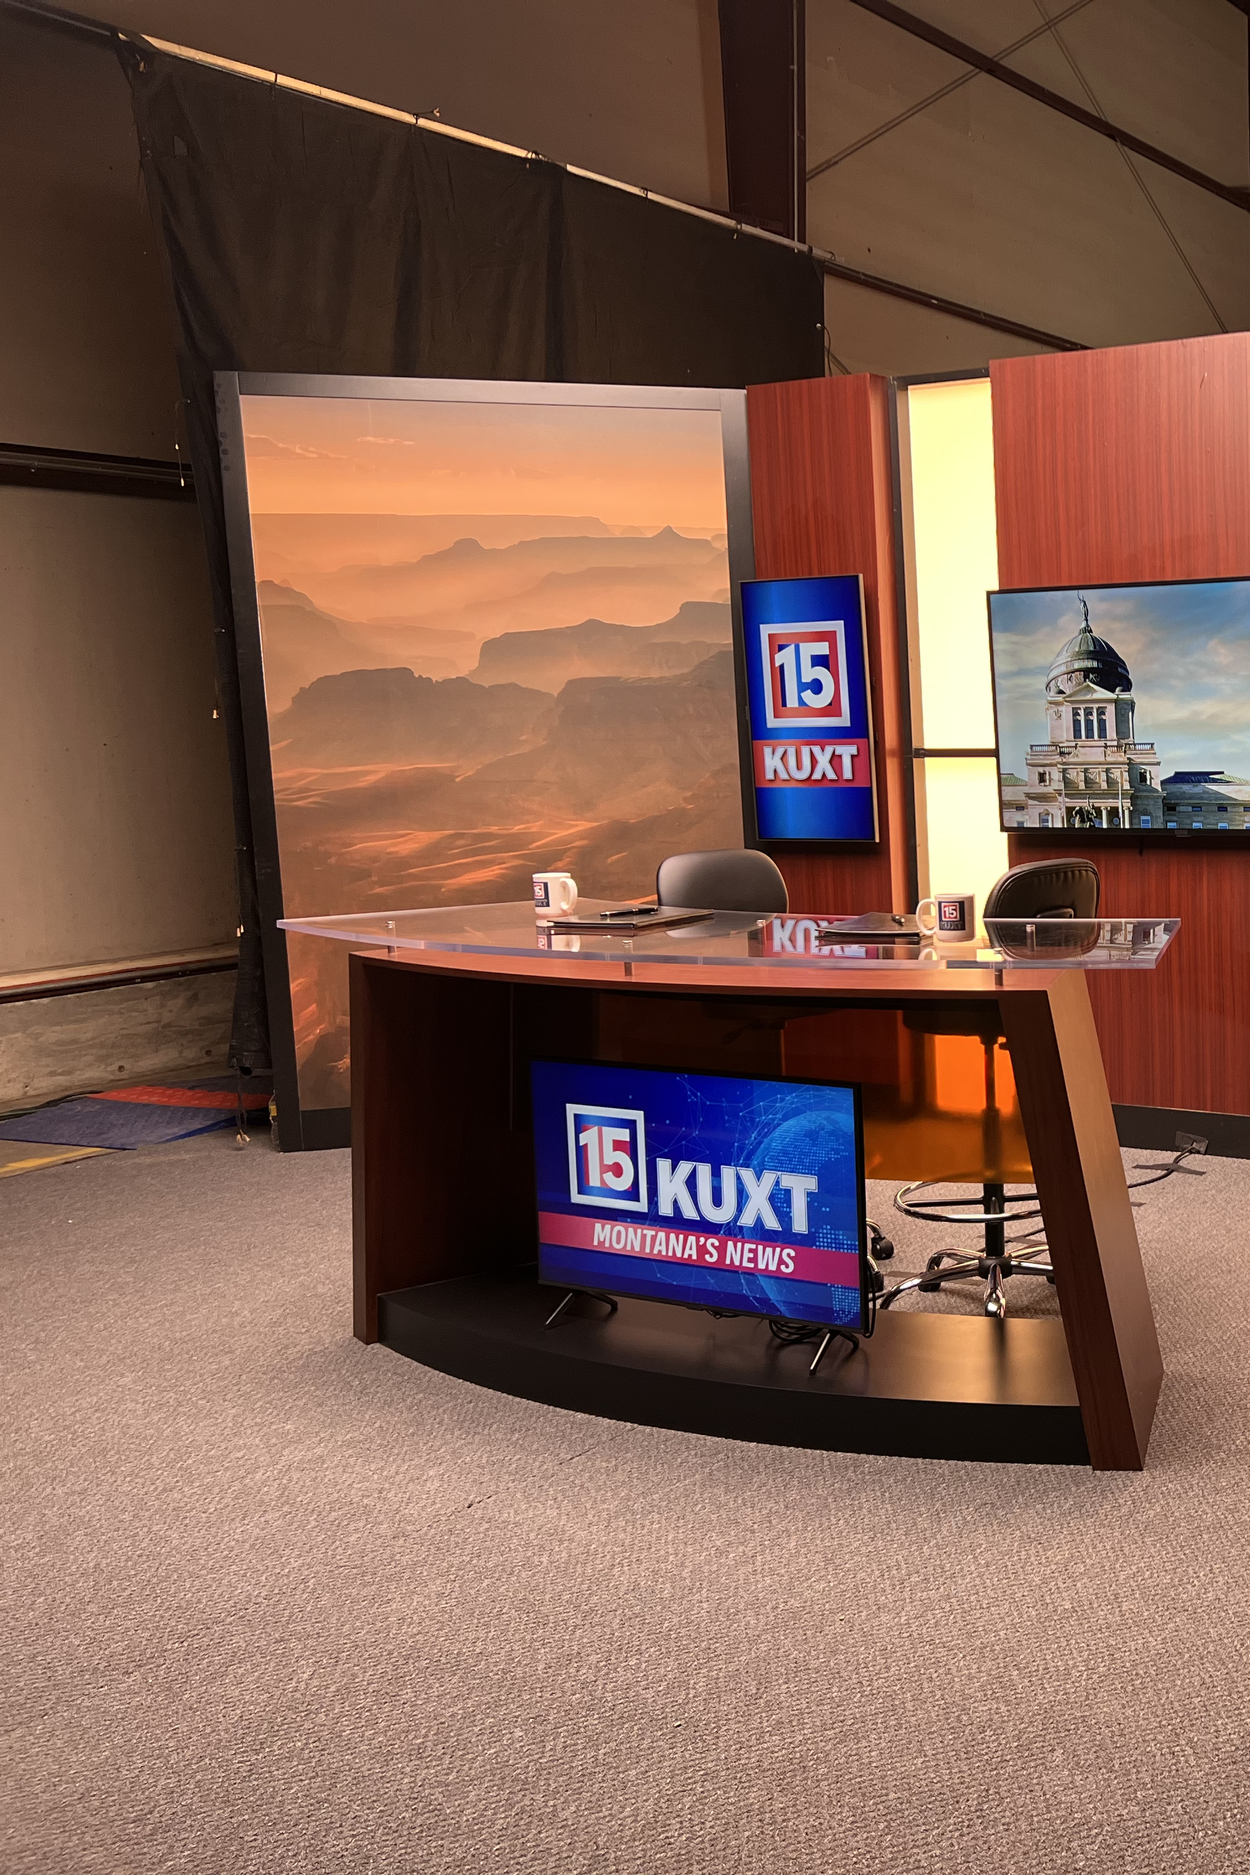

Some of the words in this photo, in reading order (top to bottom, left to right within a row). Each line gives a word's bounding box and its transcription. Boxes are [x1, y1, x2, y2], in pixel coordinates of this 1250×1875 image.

[774, 641, 835, 708] 15
[763, 744, 857, 781] KUXT
[944, 906, 957, 918] 15
[579, 1125, 634, 1191] 15
[656, 1158, 818, 1234] KUXT
[593, 1223, 720, 1263] MONTANA'S
[725, 1242, 796, 1273] NEWS
